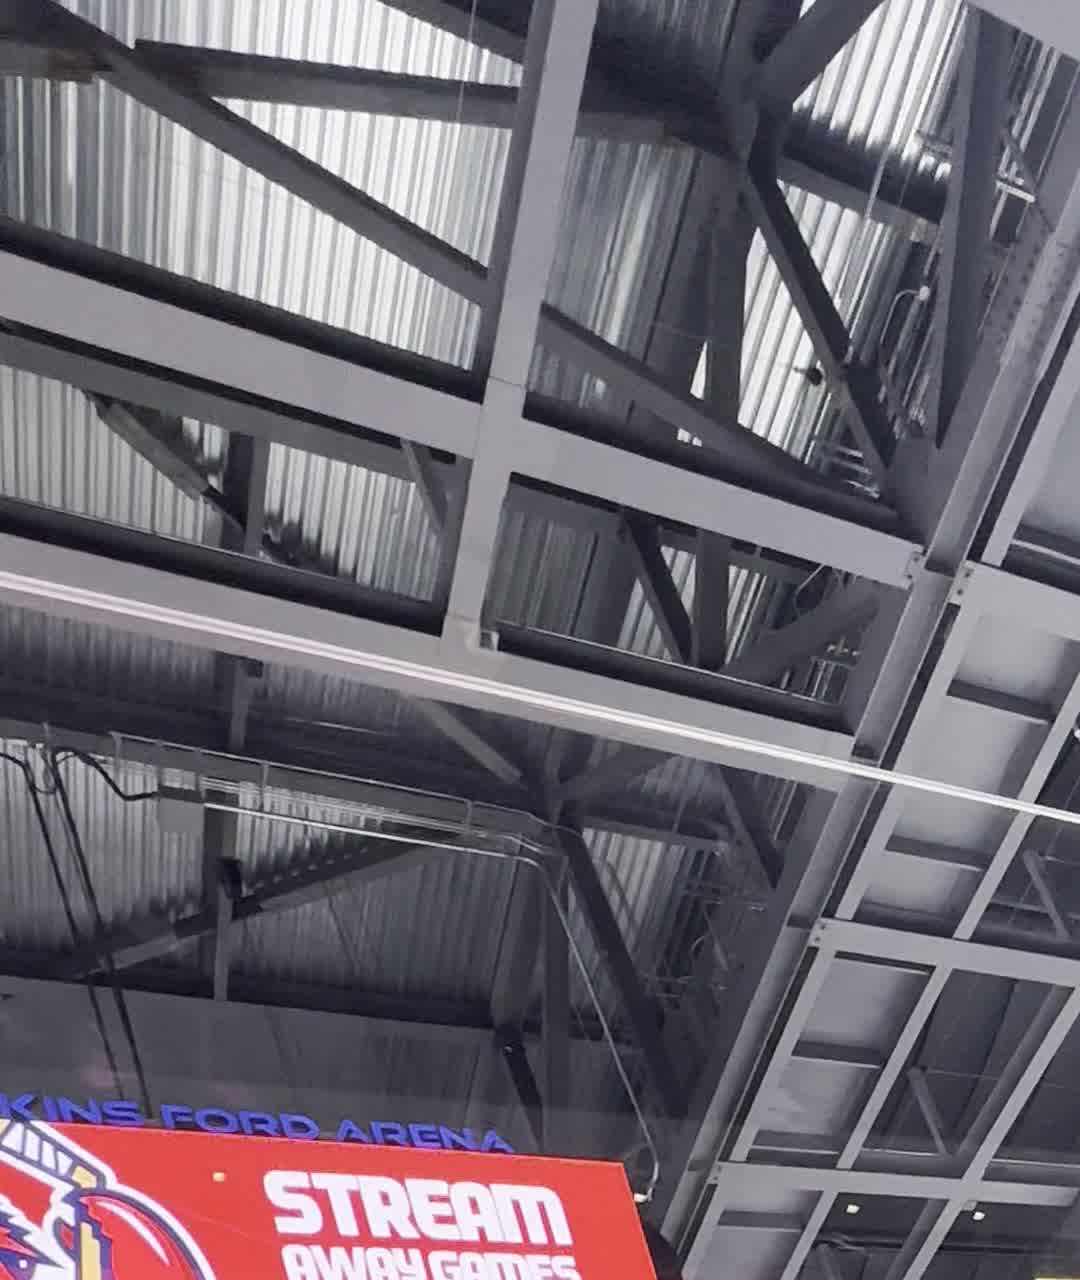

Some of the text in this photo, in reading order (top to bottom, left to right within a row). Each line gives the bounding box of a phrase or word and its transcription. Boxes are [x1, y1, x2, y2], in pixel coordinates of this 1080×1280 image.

[160, 1104, 320, 1139] FORD
[336, 1119, 515, 1152] ARENA
[263, 1169, 574, 1246] STREAM
